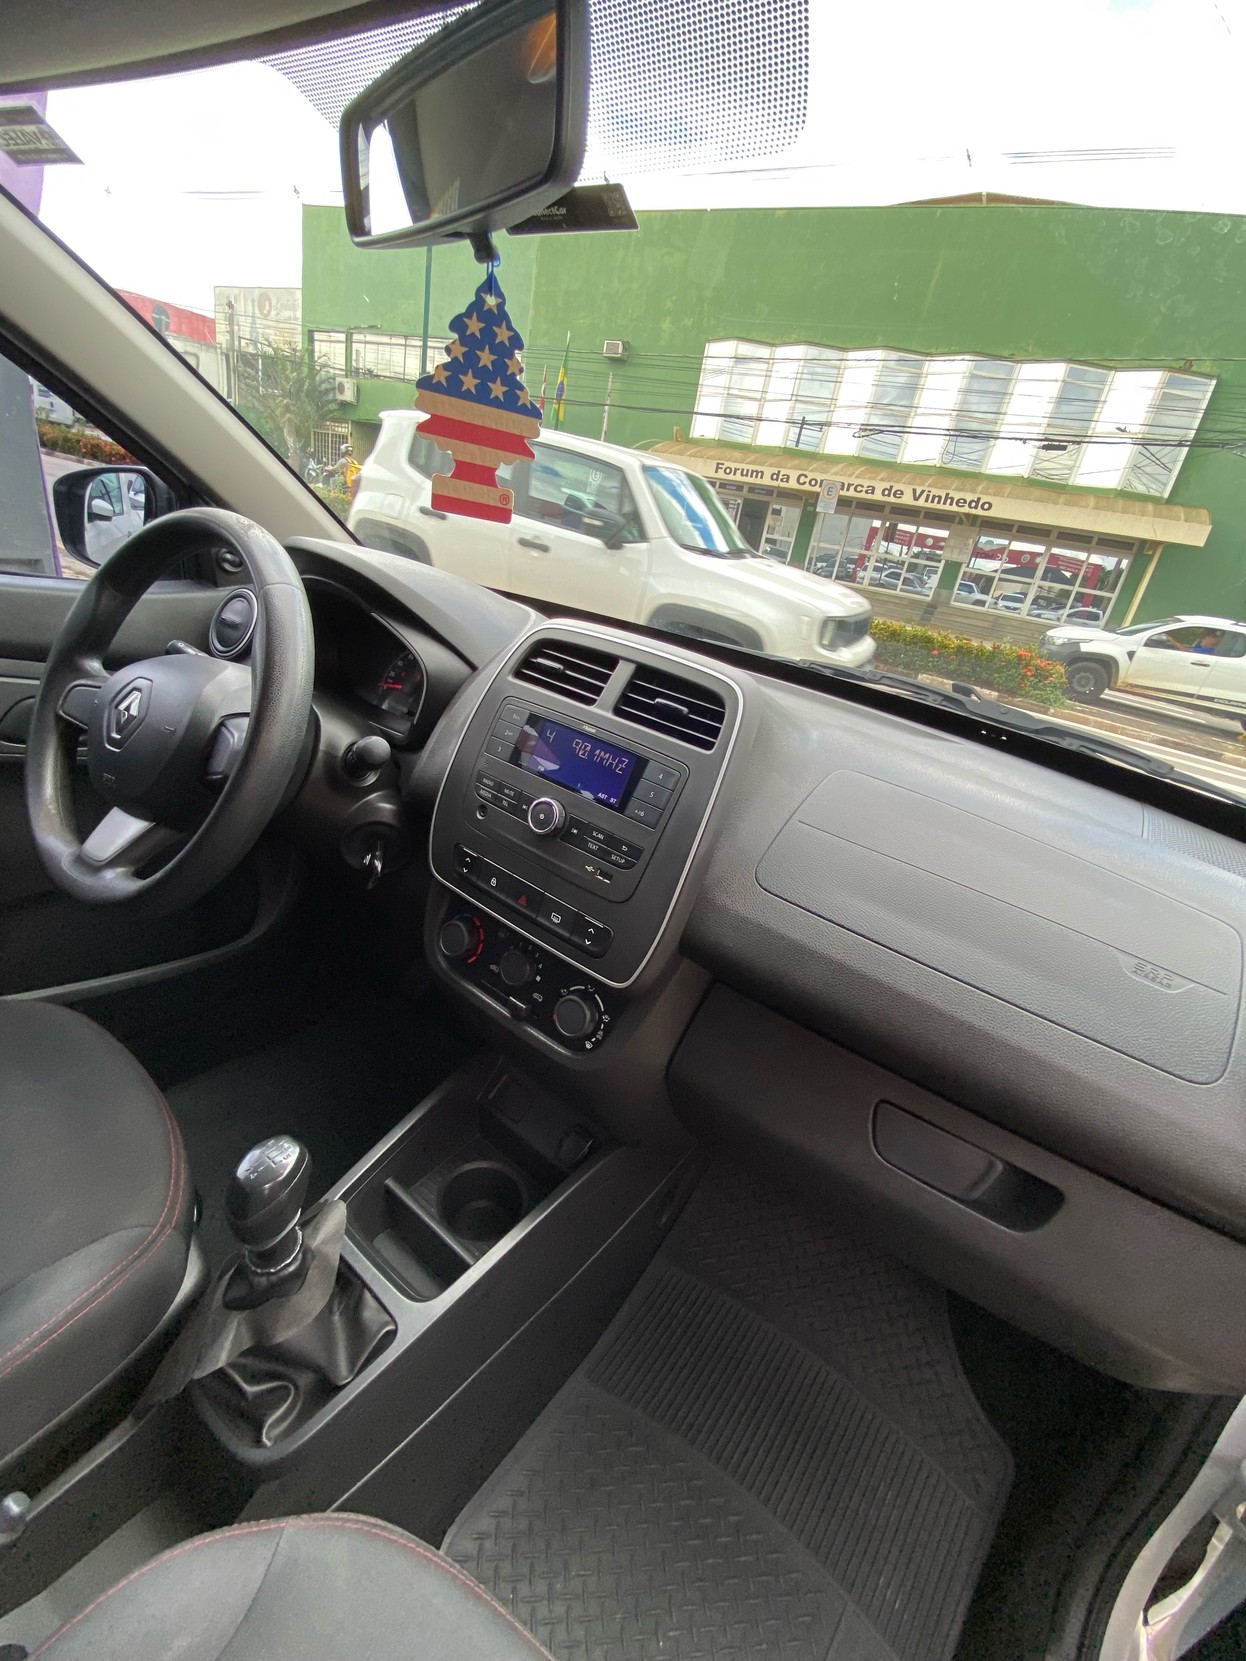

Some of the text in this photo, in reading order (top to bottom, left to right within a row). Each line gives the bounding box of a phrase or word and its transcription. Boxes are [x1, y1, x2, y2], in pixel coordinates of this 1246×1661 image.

[714, 462, 993, 512] Forum da Coarca de Vinhedo
[504, 788, 515, 797] MUTE
[597, 791, 609, 801] AST
[592, 831, 605, 840] SCAN
[587, 842, 599, 851] TEXT
[610, 854, 626, 864] SETUP
